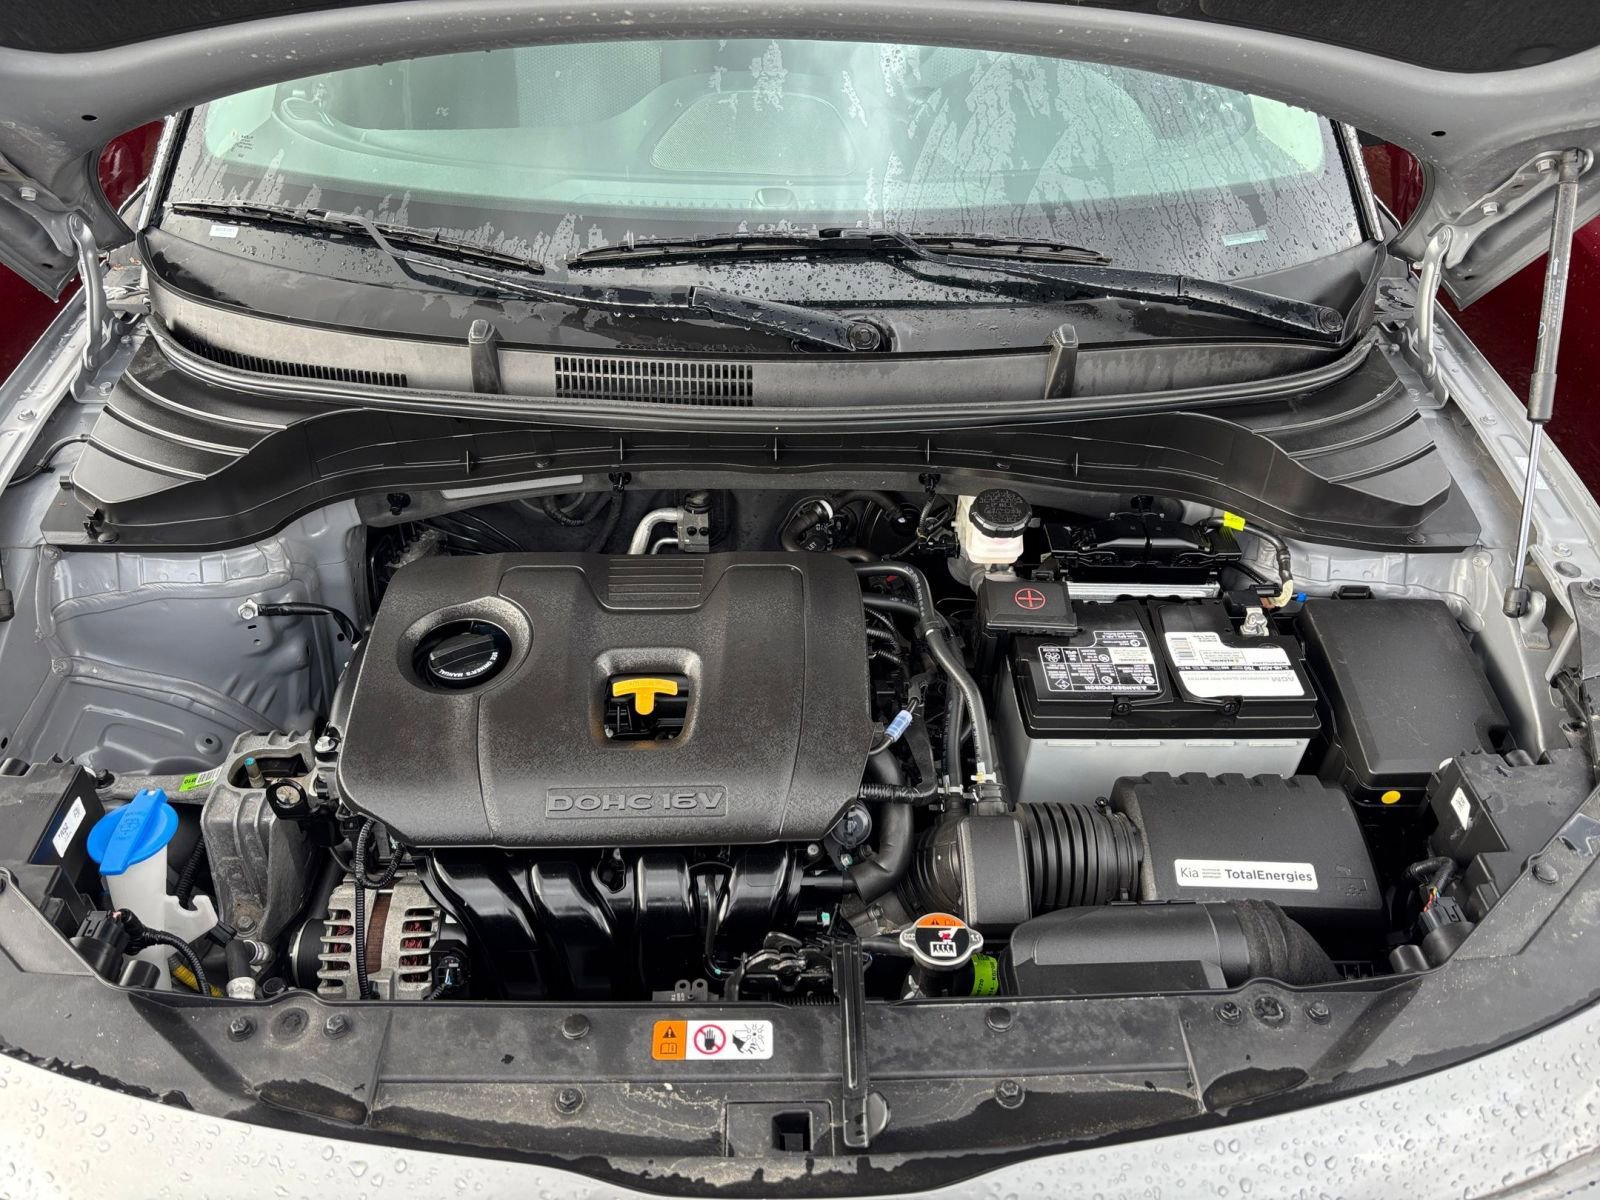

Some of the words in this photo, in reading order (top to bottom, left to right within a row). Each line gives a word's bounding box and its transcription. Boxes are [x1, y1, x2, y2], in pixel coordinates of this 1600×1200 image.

[438, 668, 464, 677] MANUAL
[548, 793, 653, 811] DOHC
[662, 792, 723, 809] 16V
[1180, 867, 1199, 878] Kia
[1225, 869, 1313, 883] TotalEnergies
